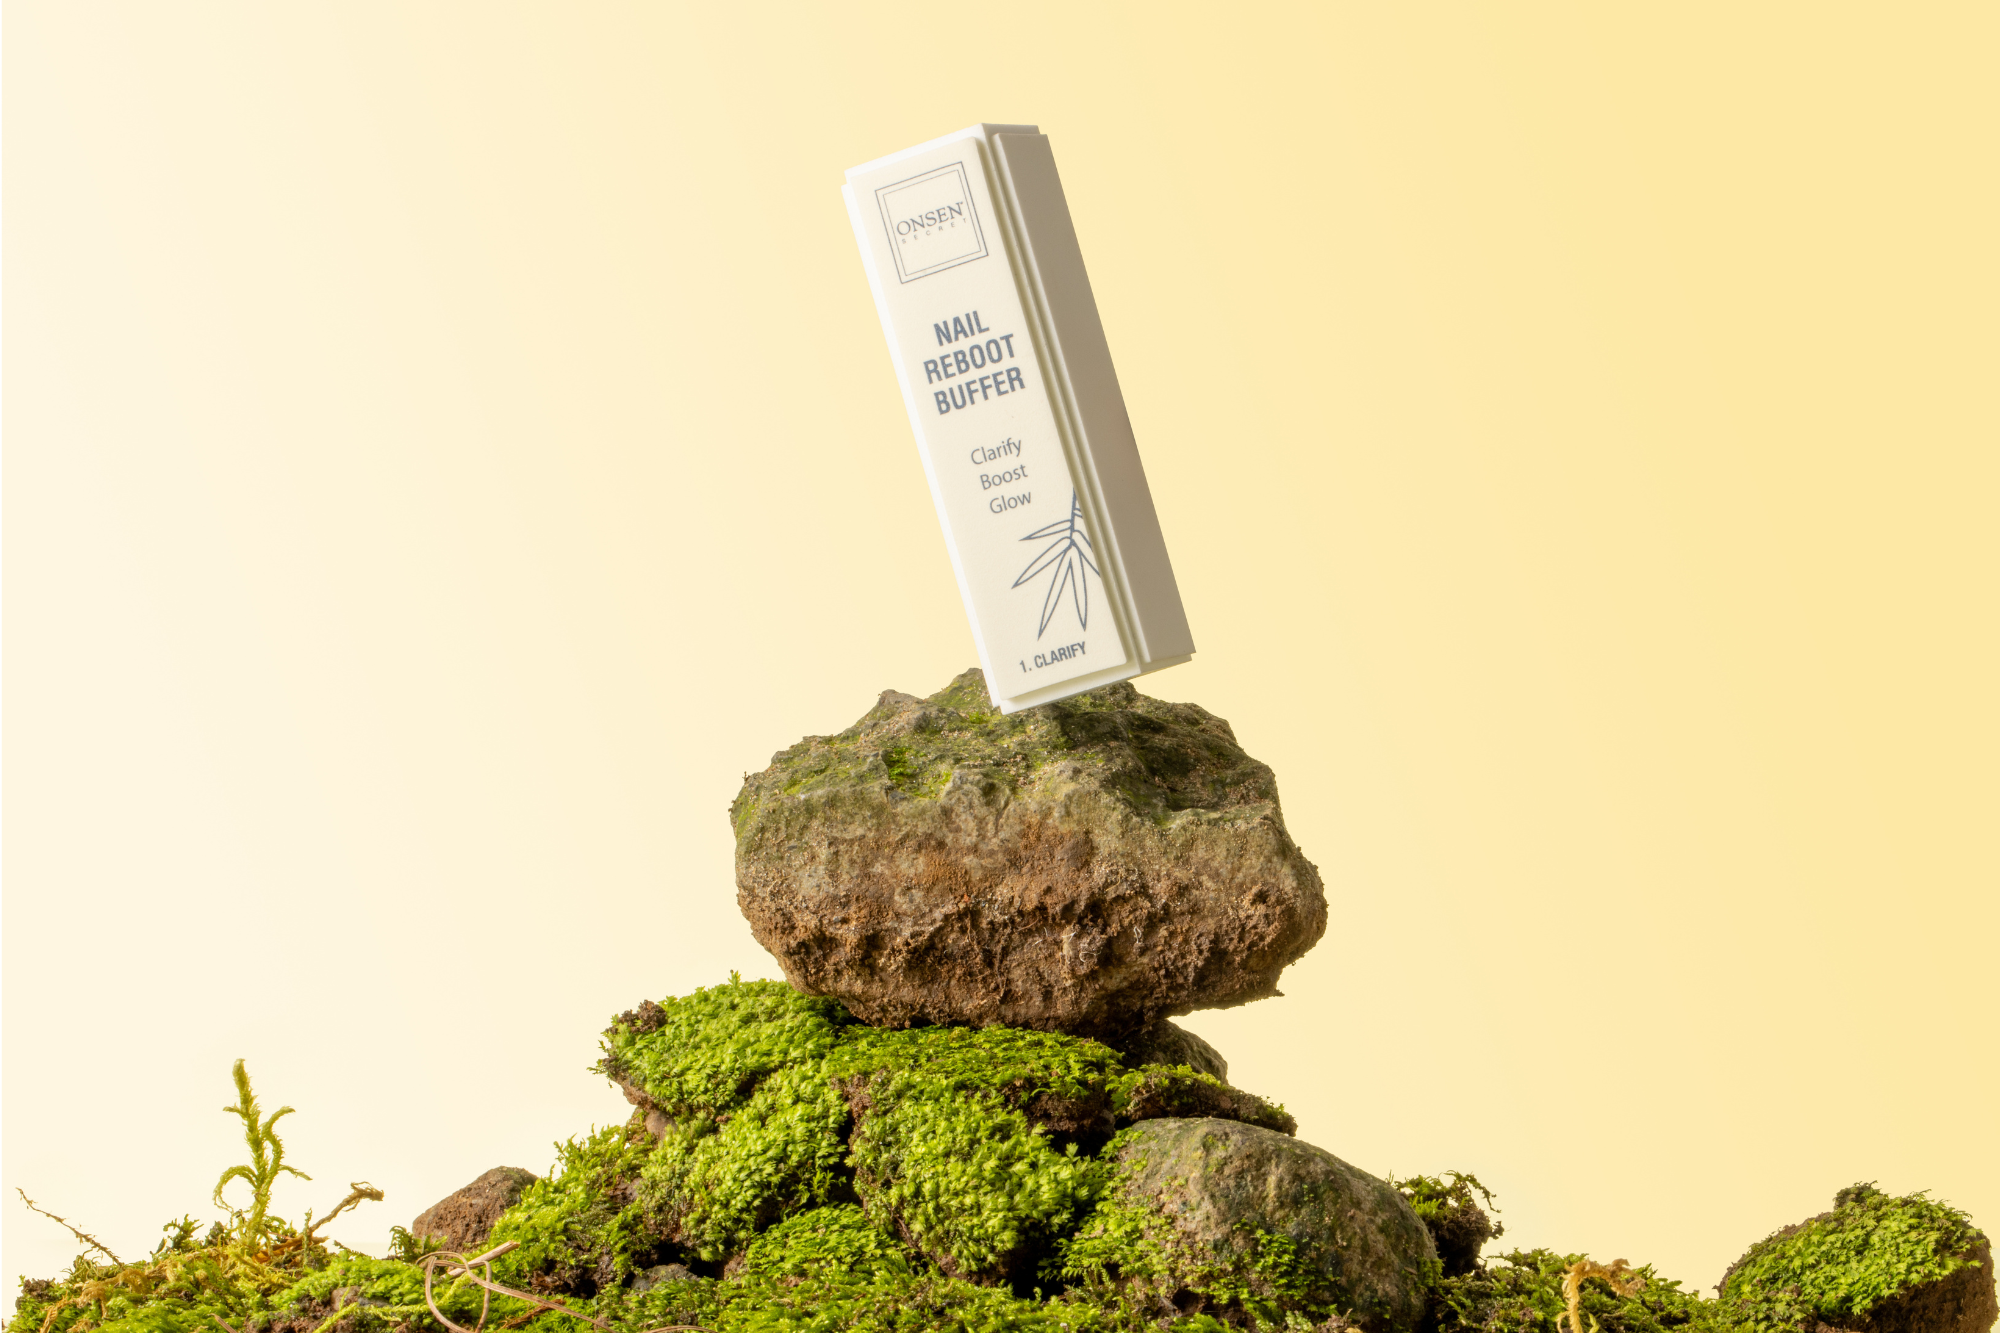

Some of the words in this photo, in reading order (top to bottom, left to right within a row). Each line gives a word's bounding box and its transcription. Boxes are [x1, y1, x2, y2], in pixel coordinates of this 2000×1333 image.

[902, 217, 967, 244] SECRET
[933, 310, 990, 346] NAIL
[923, 333, 1015, 384] REBOOT
[933, 366, 1025, 415] BUFFER
[971, 437, 1022, 465] Clarify
[980, 464, 1028, 490] Boost
[989, 491, 1032, 514] Glow
[1019, 659, 1032, 673] 1.
[1034, 641, 1086, 669] CLARIFY
